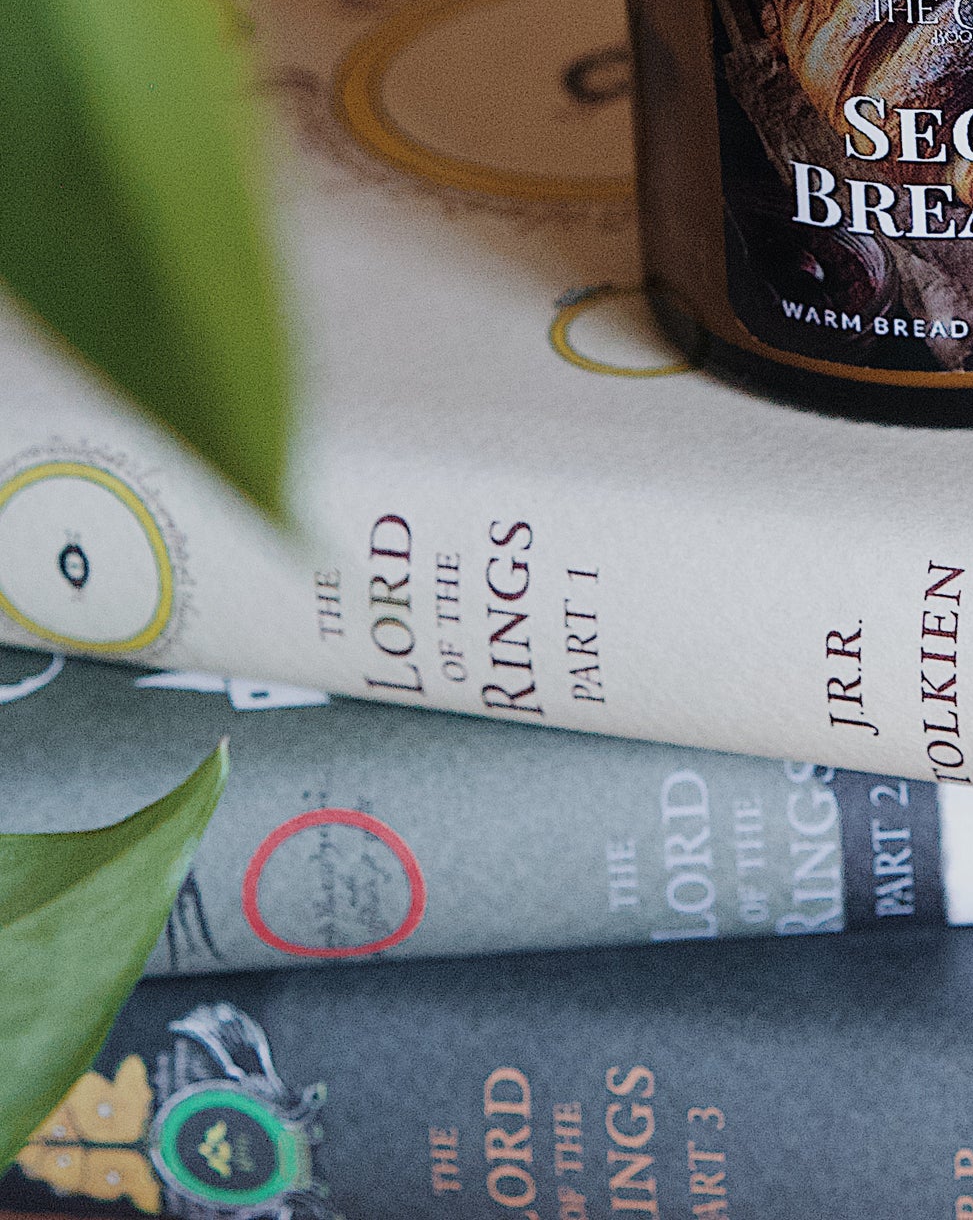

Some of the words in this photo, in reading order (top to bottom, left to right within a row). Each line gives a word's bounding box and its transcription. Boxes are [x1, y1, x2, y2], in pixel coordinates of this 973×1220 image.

[781, 299, 862, 333] WARM
[873, 316, 970, 340] BREAD
[314, 568, 345, 641] THE
[363, 514, 425, 694] LORD
[434, 553, 461, 628] THE
[566, 567, 599, 584] 1
[481, 520, 545, 716] RINGS
[564, 598, 606, 703] PART
[437, 639, 468, 683] OF
[826, 618, 880, 737] J.R.R.
[920, 559, 972, 784] TOLKIEN
[868, 780, 910, 808] 2
[606, 836, 640, 912] THE
[650, 769, 719, 943] LORD
[733, 795, 768, 877] THE
[871, 817, 916, 918] PART
[737, 883, 771, 925] OF
[484, 1066, 541, 1220] ORD
[552, 1101, 585, 1177] THE
[605, 1064, 661, 1220] INGS
[687, 1105, 726, 1130] 3
[429, 1127, 463, 1197] THE
[688, 1140, 730, 1220] ART
